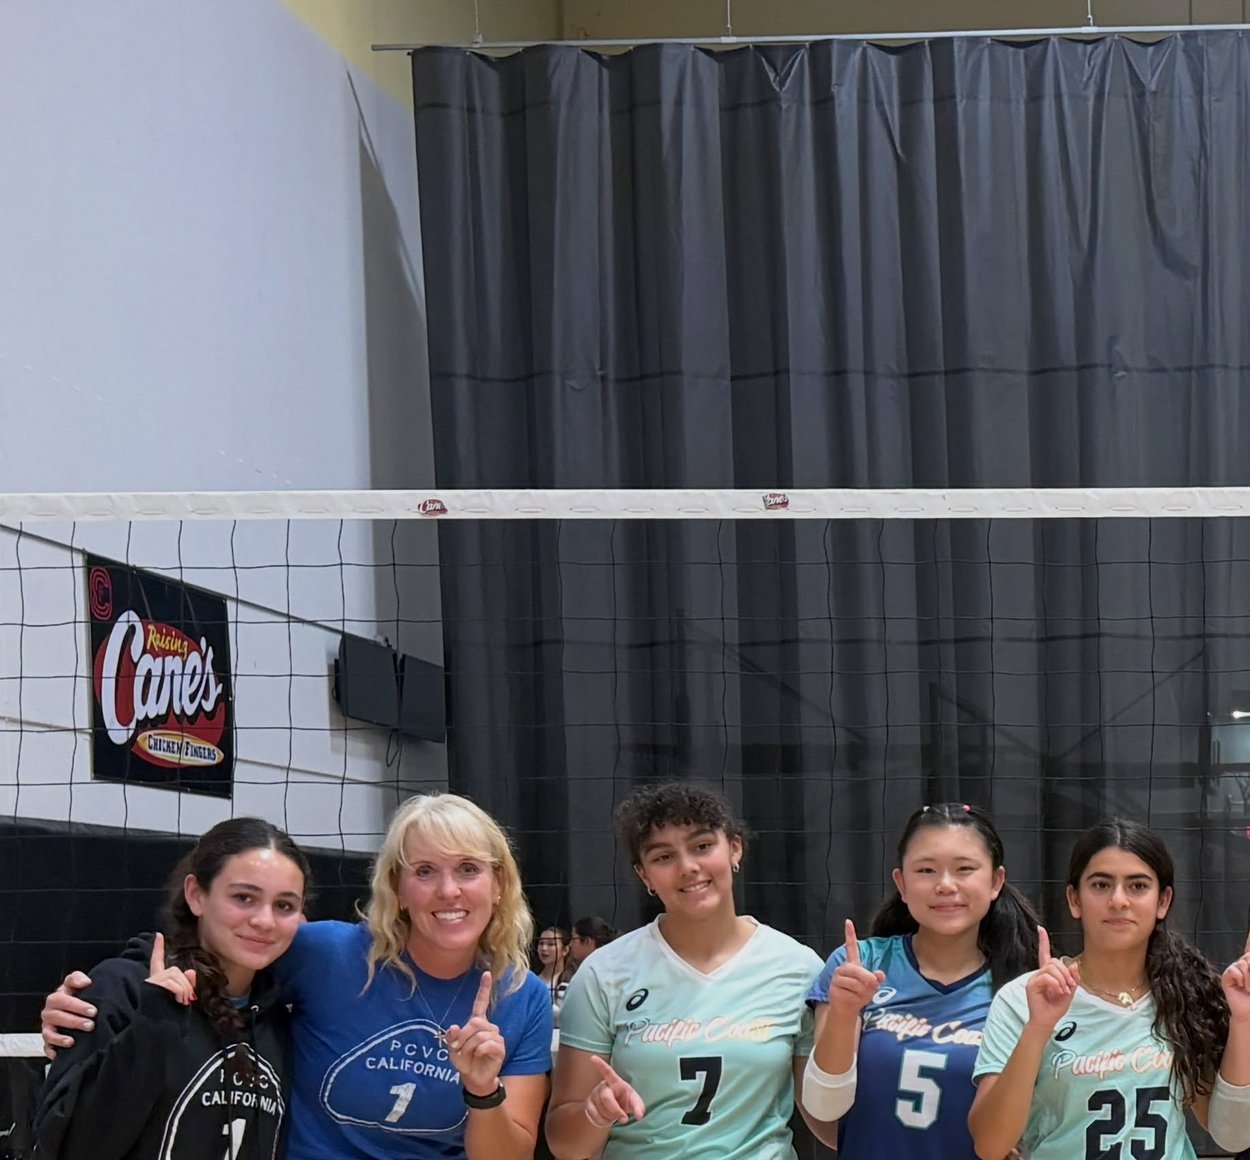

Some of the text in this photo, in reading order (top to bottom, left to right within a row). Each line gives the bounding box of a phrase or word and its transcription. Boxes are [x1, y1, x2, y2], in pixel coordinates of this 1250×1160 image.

[147, 624, 189, 658] Raising
[101, 610, 223, 745] Cane's
[148, 734, 218, 761] CHICKEN FINGERS
[623, 1017, 701, 1048] Pacific
[365, 1056, 461, 1085] CALIFORNIA
[1052, 1048, 1125, 1080] Pacific
[384, 1082, 417, 1123] 1
[679, 1055, 723, 1126] 7
[895, 1049, 948, 1130] 5
